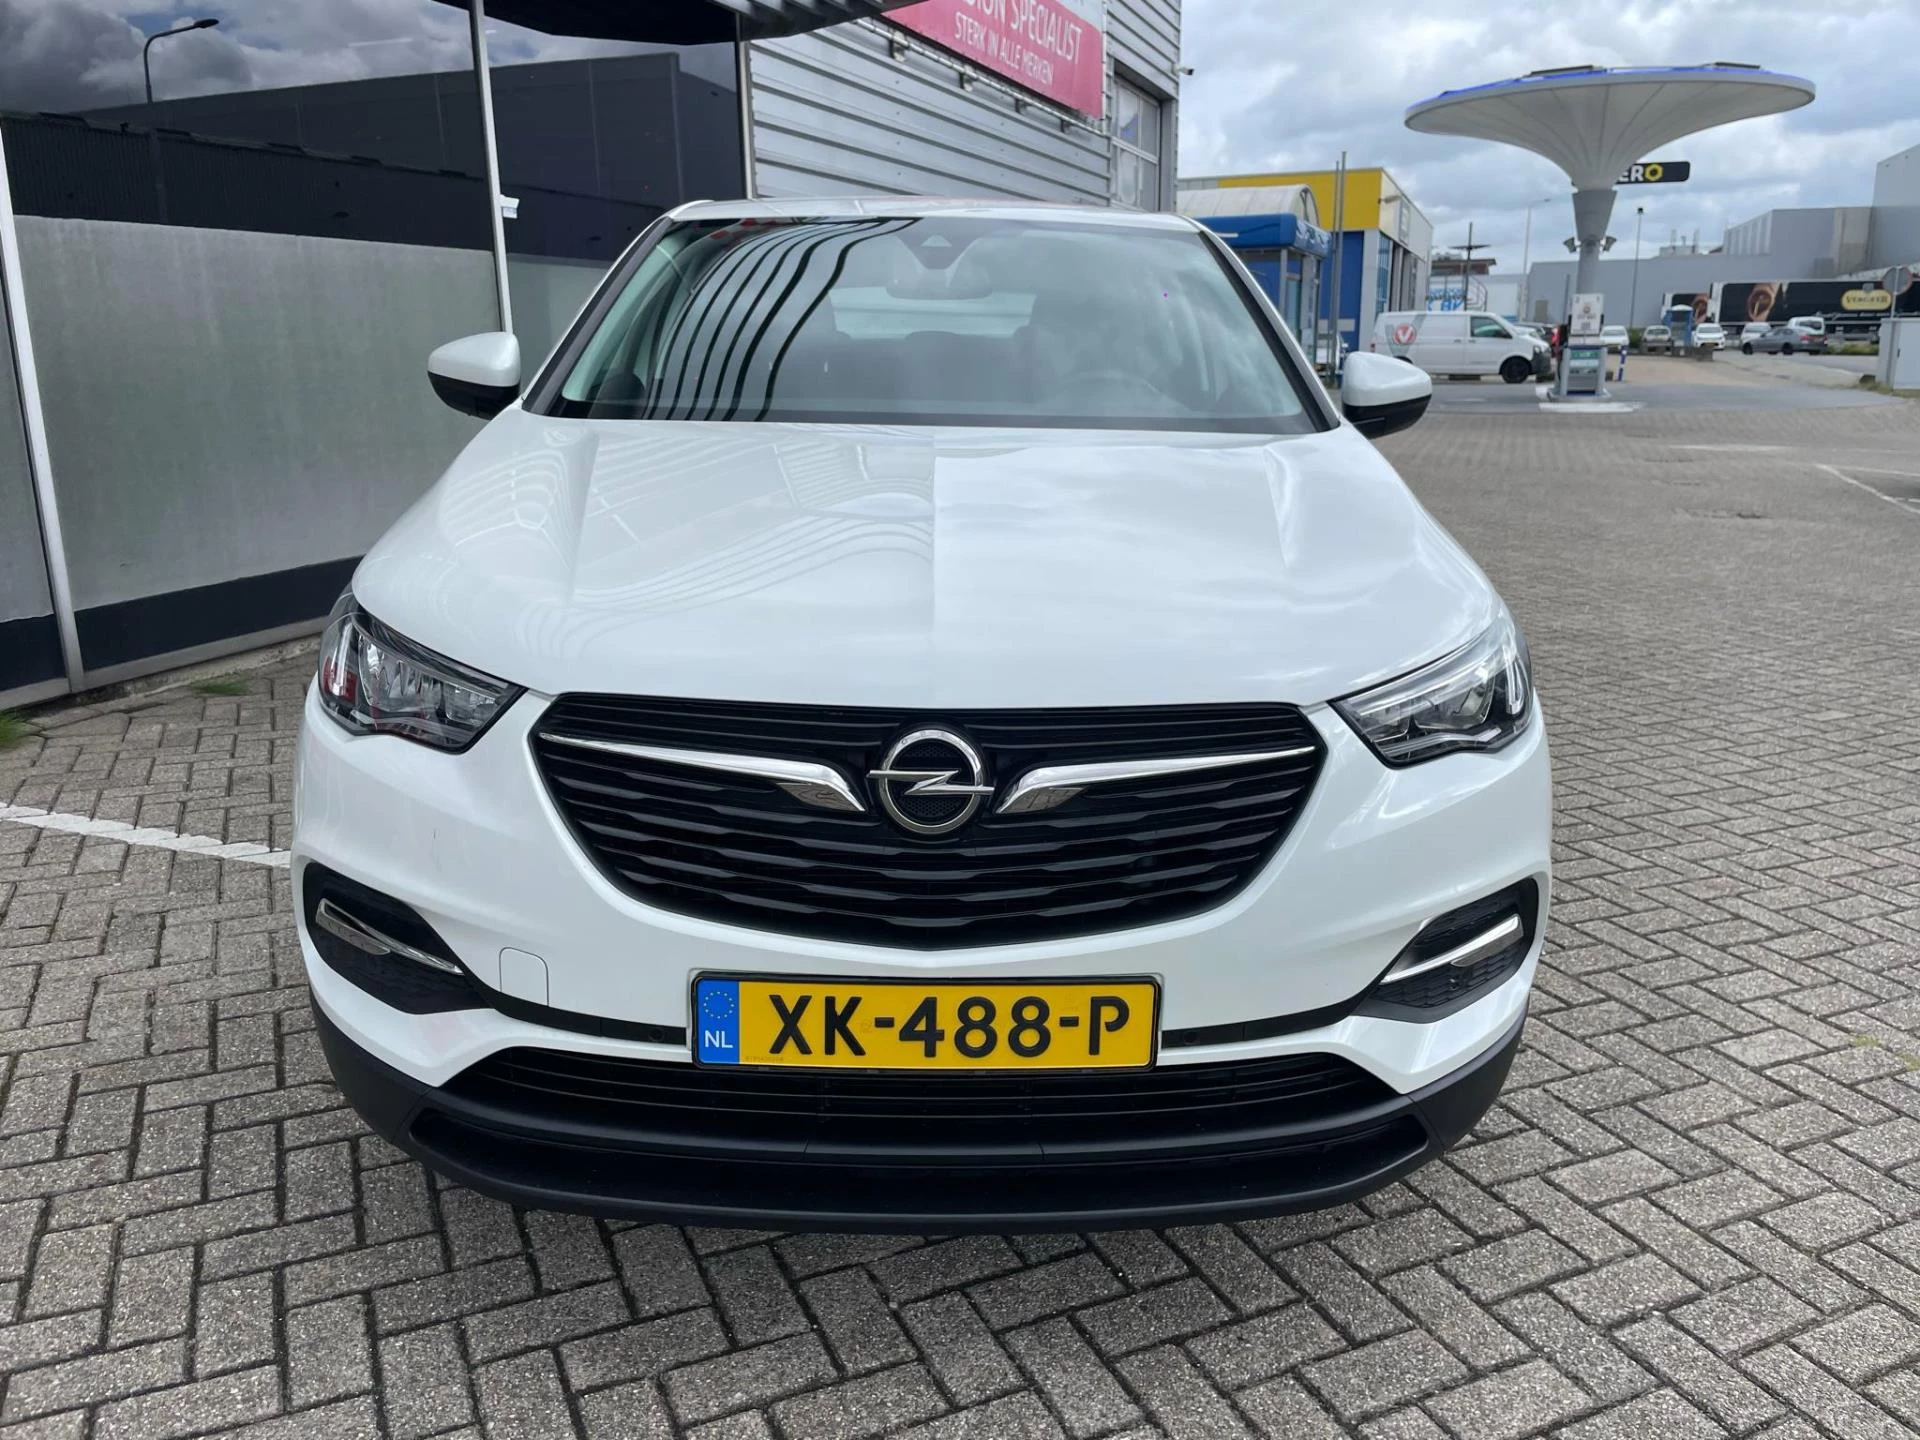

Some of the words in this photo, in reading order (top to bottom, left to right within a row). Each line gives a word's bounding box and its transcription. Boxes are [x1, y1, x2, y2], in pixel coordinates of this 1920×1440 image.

[955, 11, 987, 52] STERK
[987, 28, 1000, 57] IN
[1000, 37, 1022, 70] ALLE
[1021, 49, 1054, 85] MERKEN
[1010, 0, 1083, 64] SPECIALIST
[704, 1030, 734, 1049] NL
[768, 993, 1130, 1058] XK-488-P
